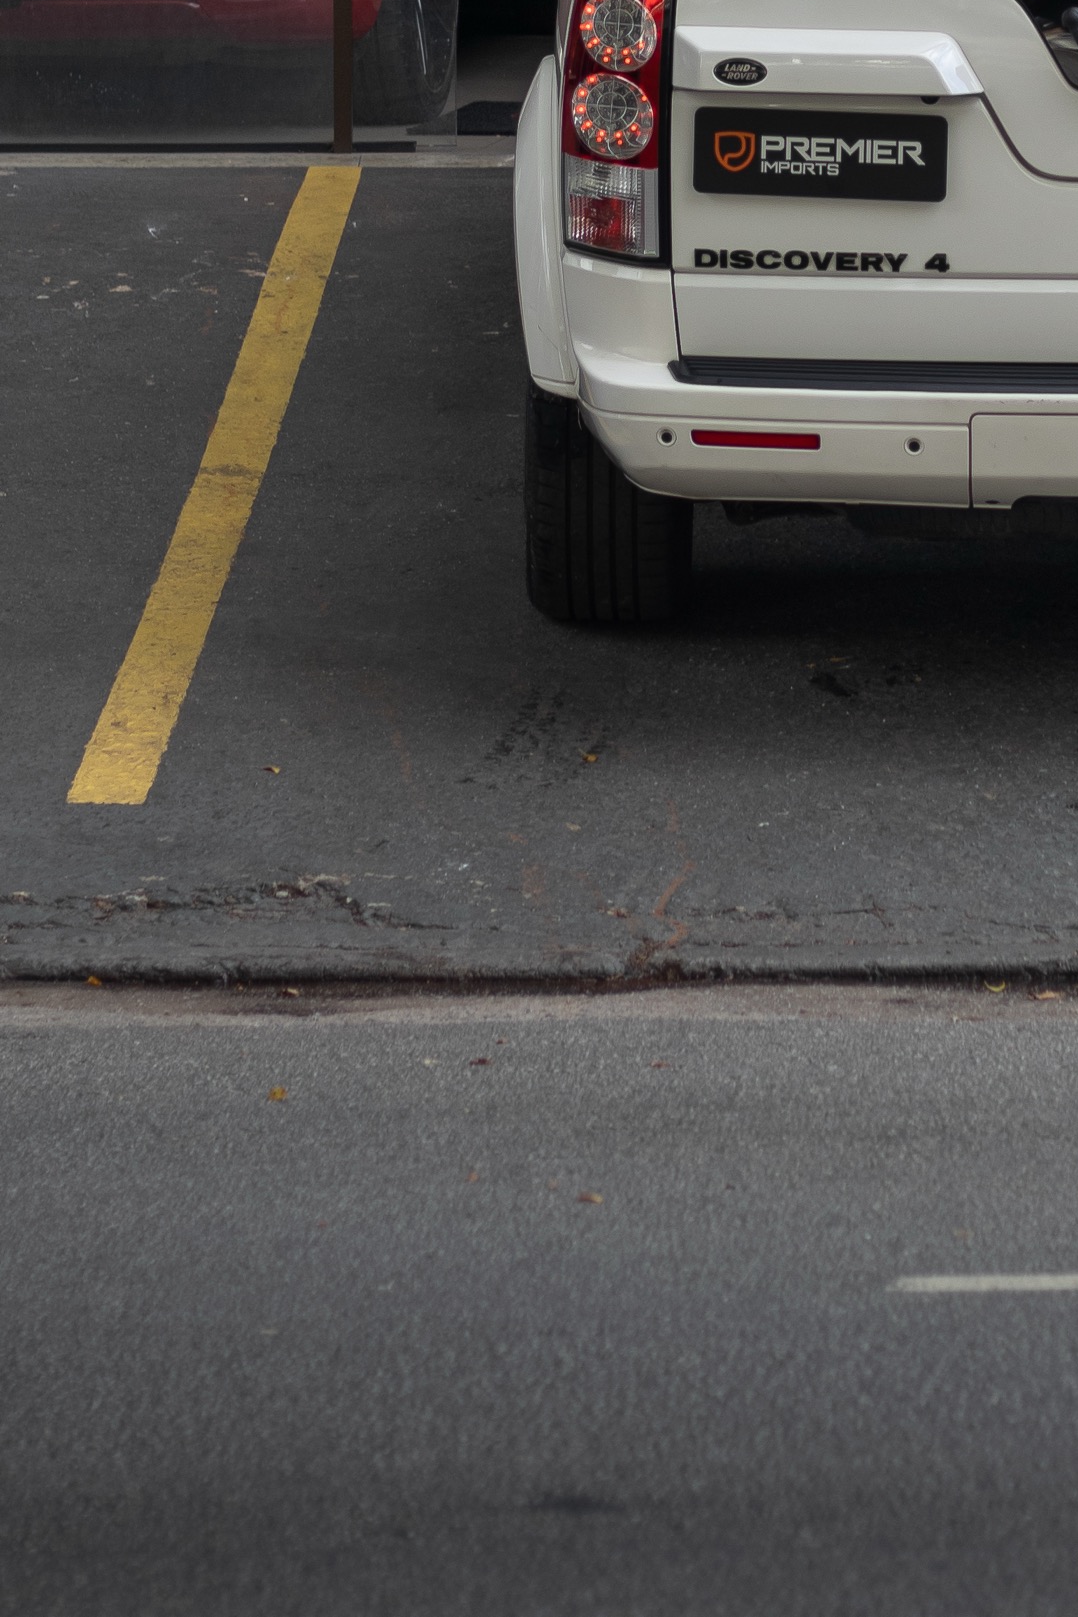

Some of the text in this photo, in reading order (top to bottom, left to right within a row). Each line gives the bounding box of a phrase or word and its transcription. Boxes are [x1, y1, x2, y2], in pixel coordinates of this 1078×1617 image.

[760, 135, 926, 166] PREMIER
[760, 161, 840, 176] IMPORTS
[693, 248, 951, 273] DISCOVERY 4
